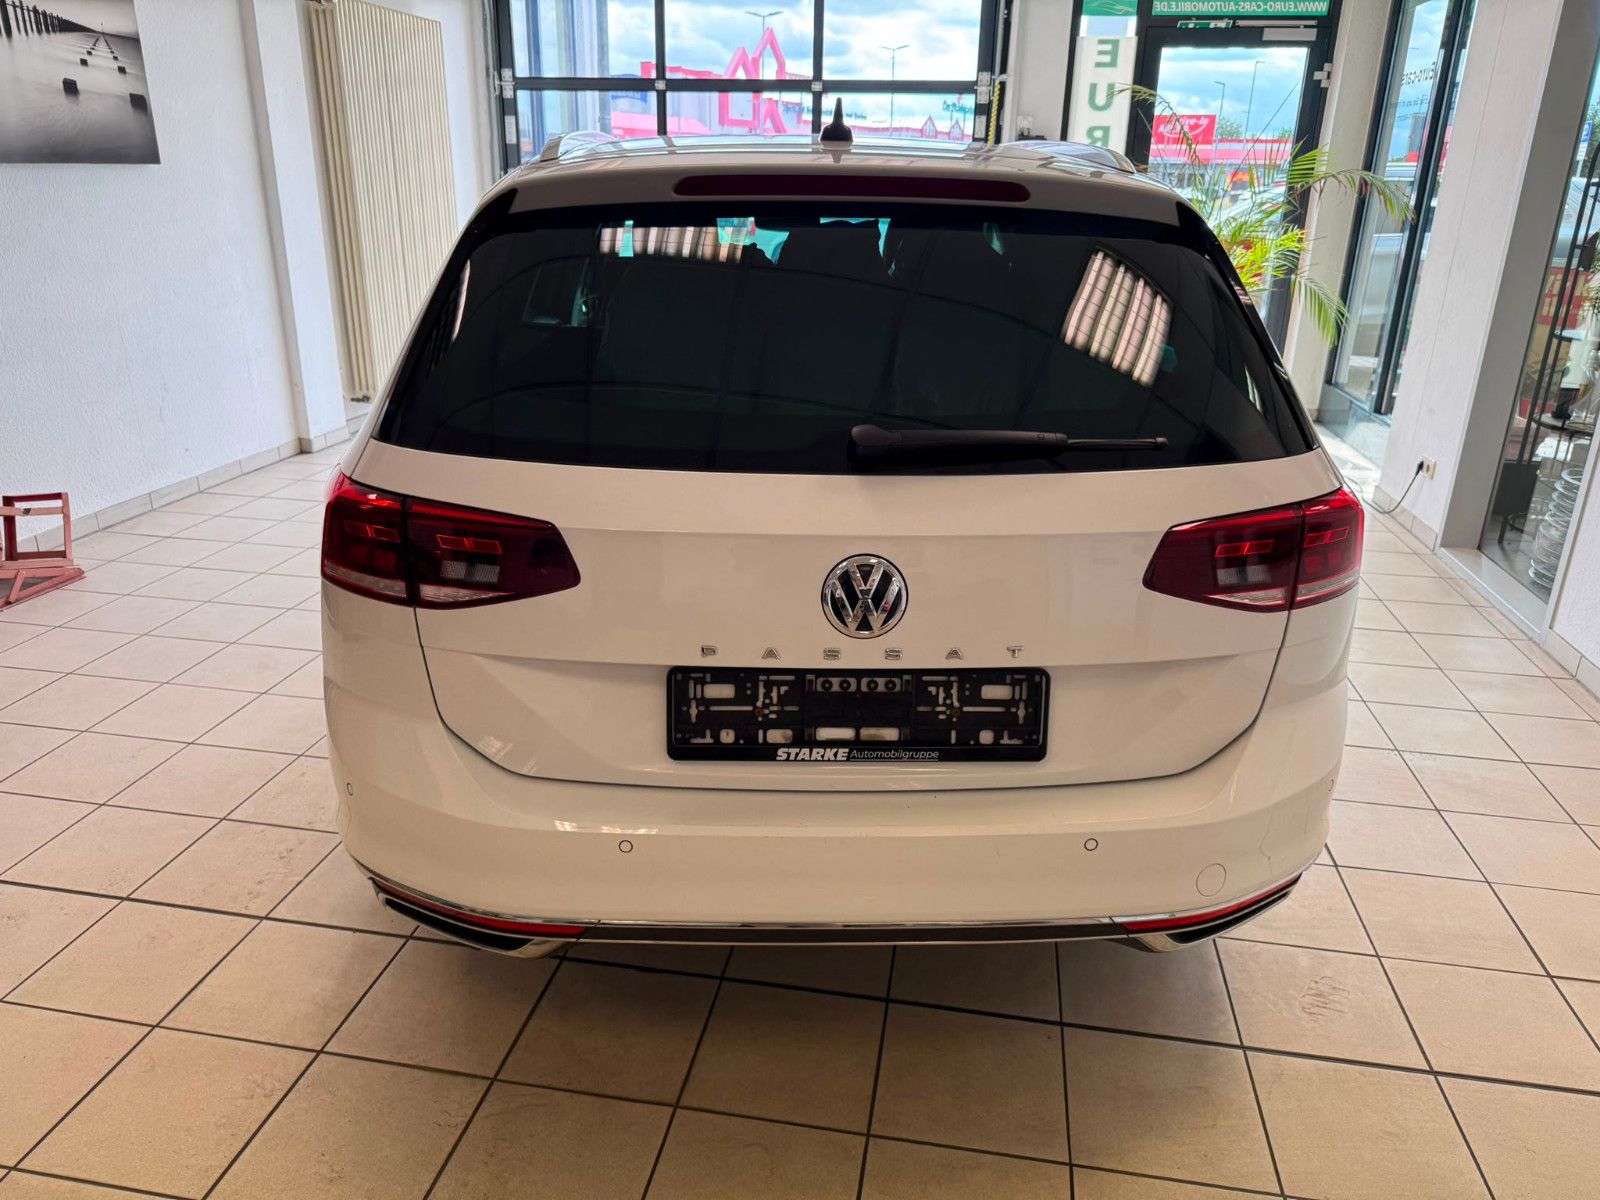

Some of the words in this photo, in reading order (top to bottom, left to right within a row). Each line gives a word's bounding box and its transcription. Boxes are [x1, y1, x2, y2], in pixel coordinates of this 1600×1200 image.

[701, 644, 1025, 661] PASSAT
[776, 747, 849, 761] STARKE
[850, 749, 940, 761] Automobilgruppe
